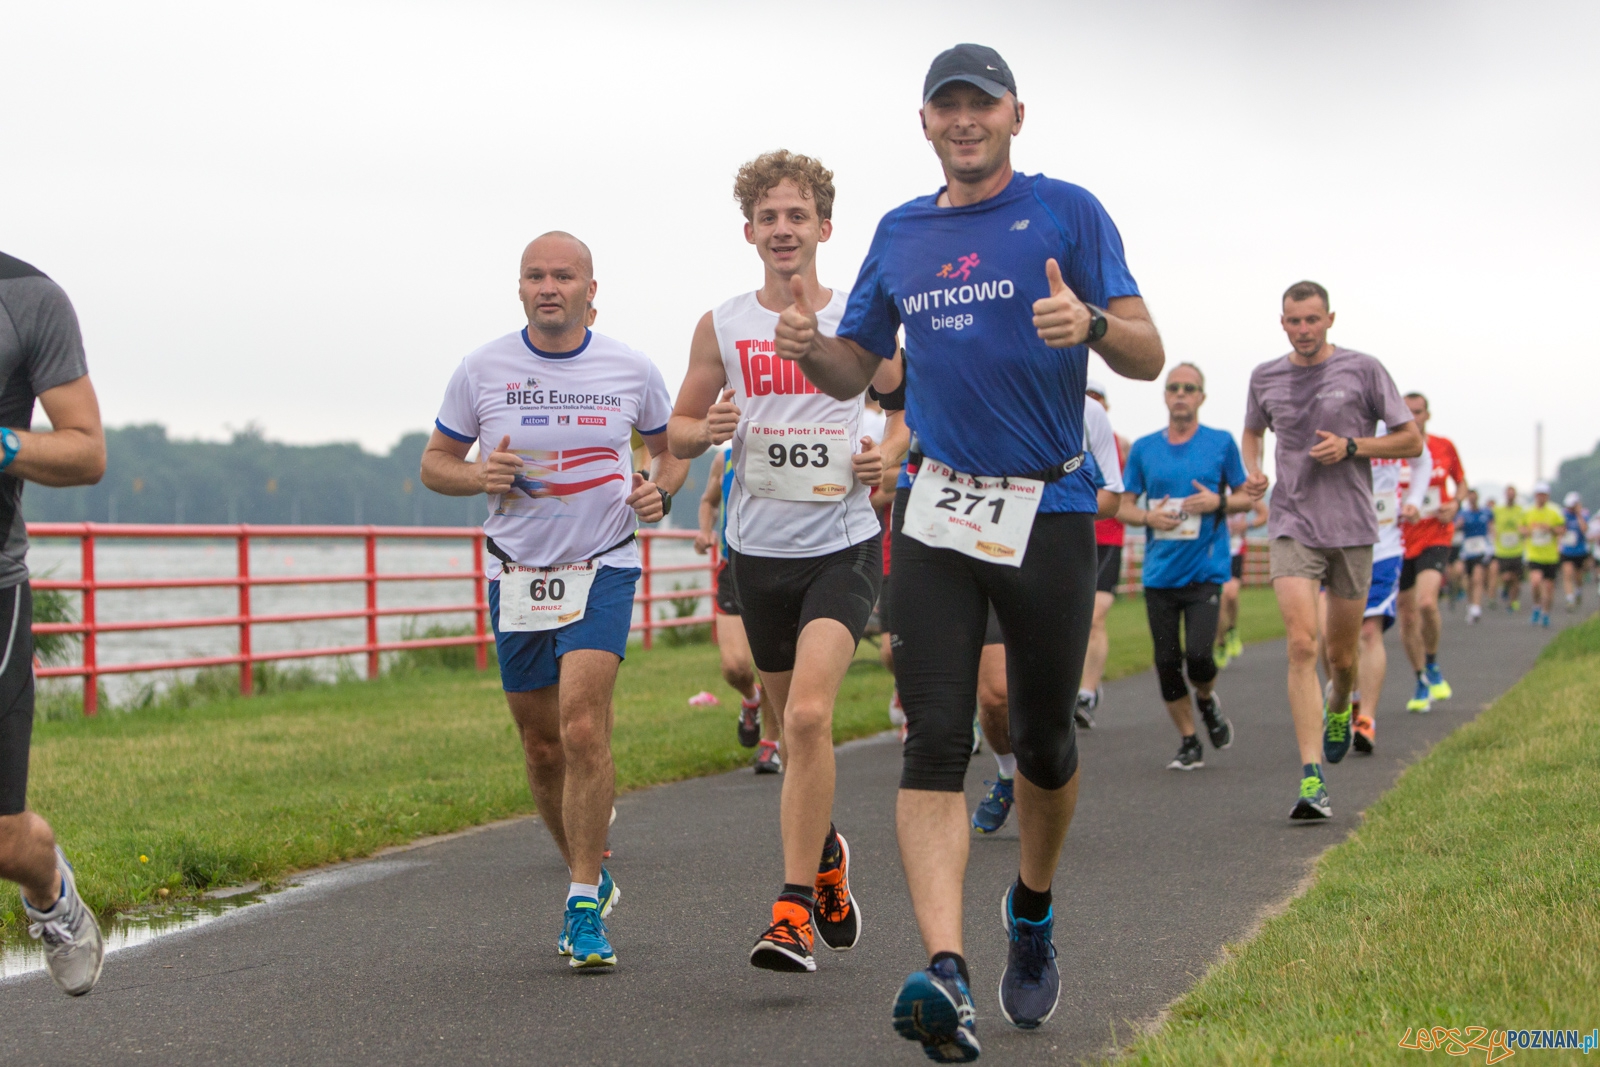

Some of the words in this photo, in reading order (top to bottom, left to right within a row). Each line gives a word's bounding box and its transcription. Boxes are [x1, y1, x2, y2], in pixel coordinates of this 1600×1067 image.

[902, 279, 1014, 315] WITKOWO
[931, 313, 974, 330] biega
[506, 382, 521, 390] XIV
[506, 390, 544, 405] BIEG
[549, 390, 621, 406] EUROPEJSKI
[580, 416, 604, 424] VELUX
[752, 427, 760, 435] IV
[763, 427, 785, 437] Bieg
[788, 427, 811, 435] Piotr
[768, 443, 829, 468] 963
[927, 463, 940, 473] IV
[935, 487, 1006, 525] 271
[530, 578, 566, 602] 60
